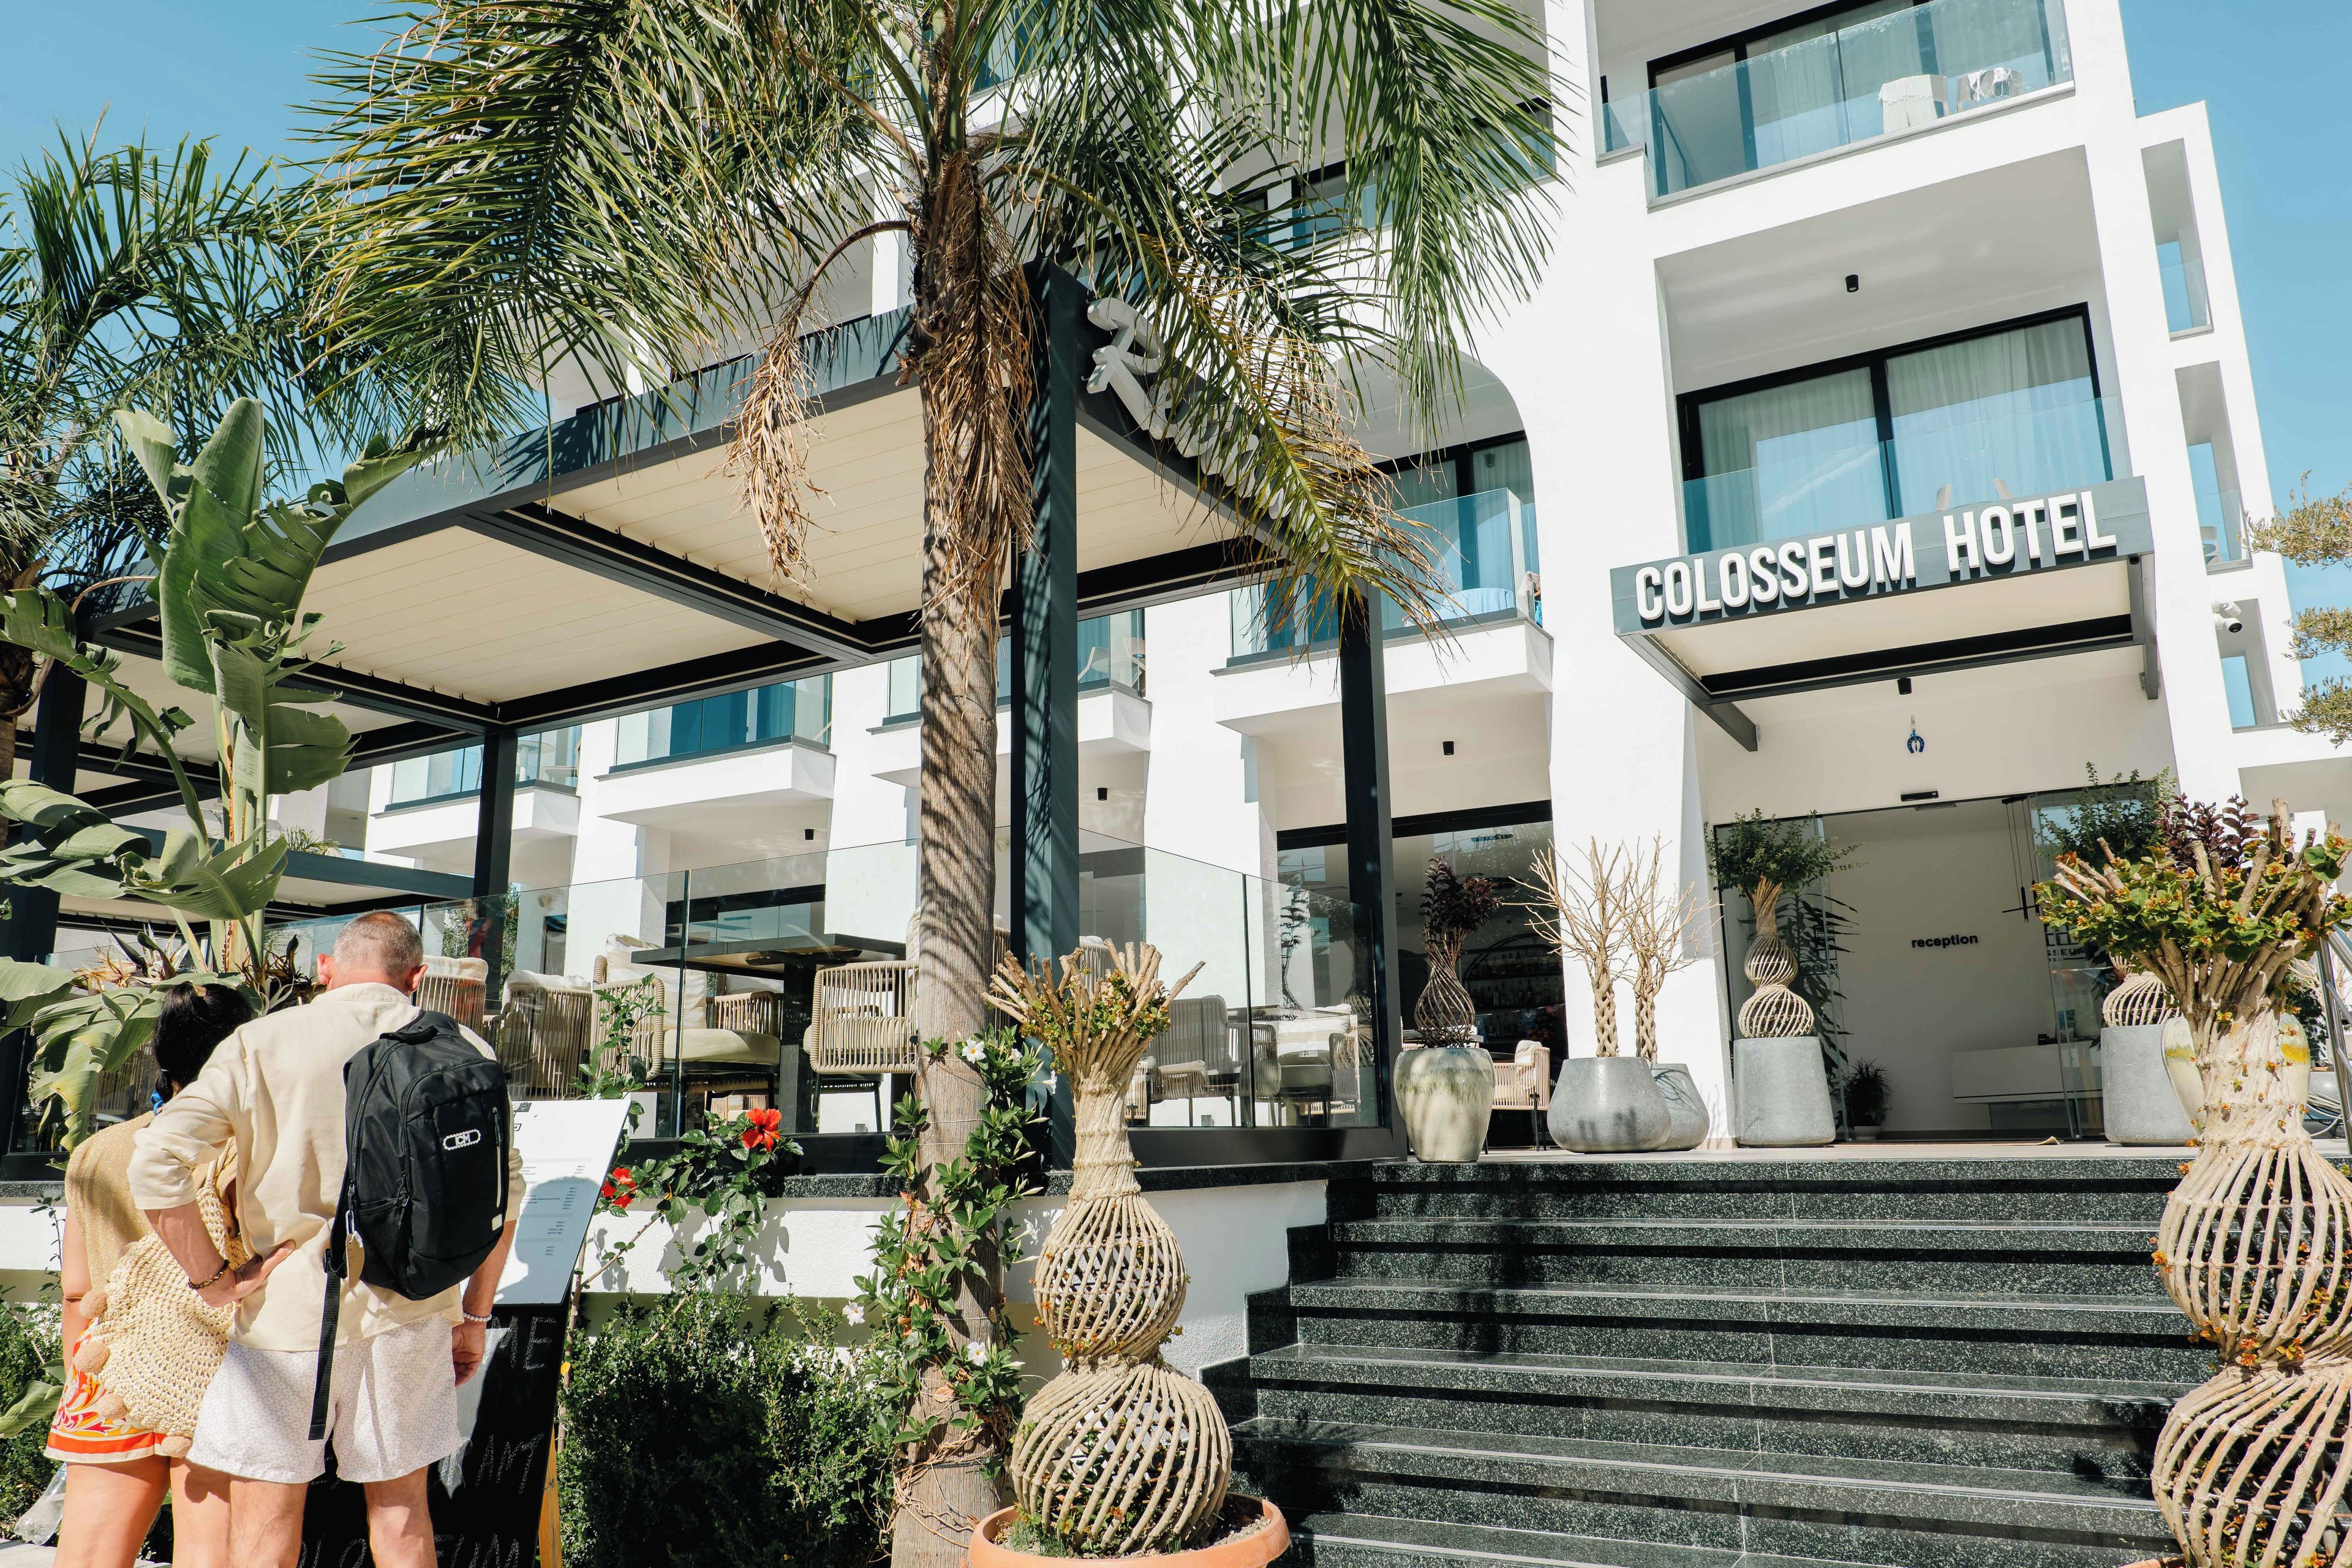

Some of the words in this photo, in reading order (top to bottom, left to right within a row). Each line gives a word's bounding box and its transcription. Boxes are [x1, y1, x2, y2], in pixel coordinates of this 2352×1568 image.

[1635, 522, 1917, 621] COLOSSEUM
[1943, 490, 2117, 572] HOTEL
[1911, 934, 1978, 949] reception
